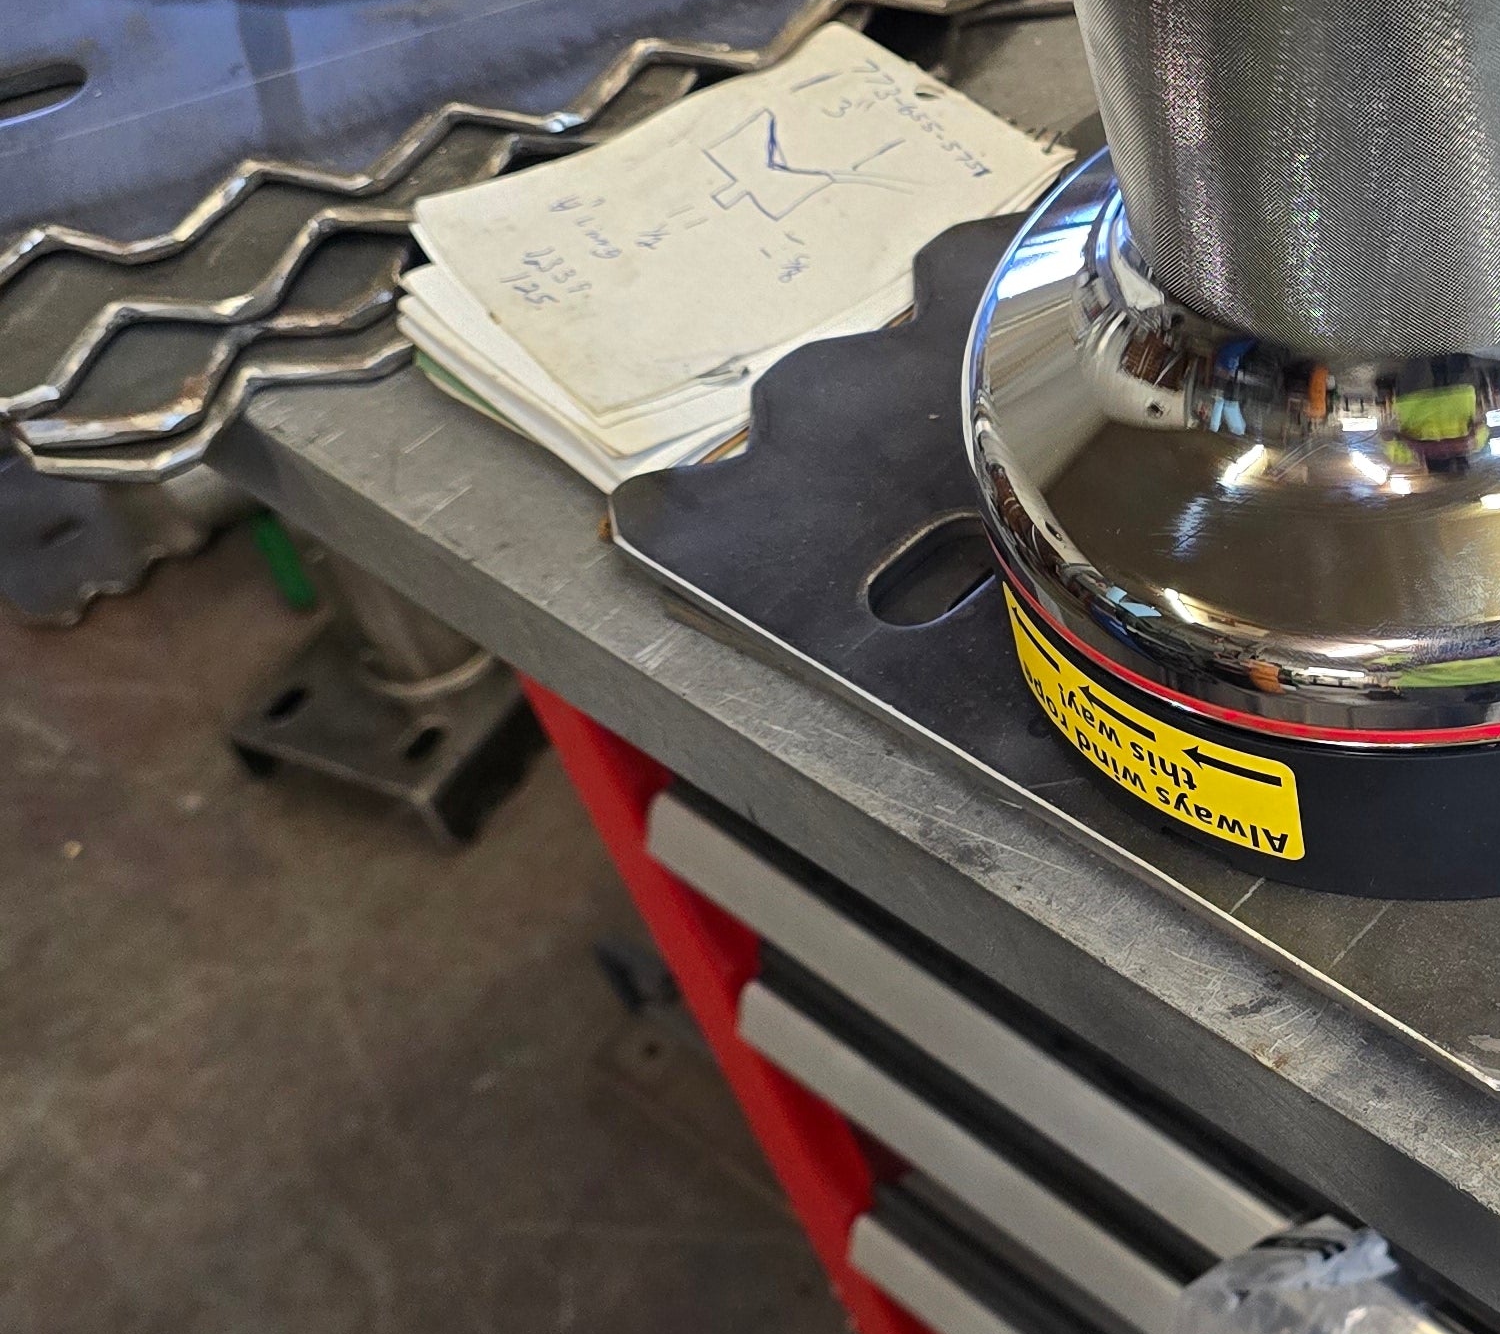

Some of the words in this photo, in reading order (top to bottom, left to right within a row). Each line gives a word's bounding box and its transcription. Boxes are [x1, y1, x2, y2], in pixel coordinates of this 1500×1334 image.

[1023, 661, 1068, 731] rope
[1058, 682, 1123, 749] way!
[1076, 728, 1147, 794] wind
[1130, 741, 1197, 791] this
[1156, 786, 1289, 854] Always
